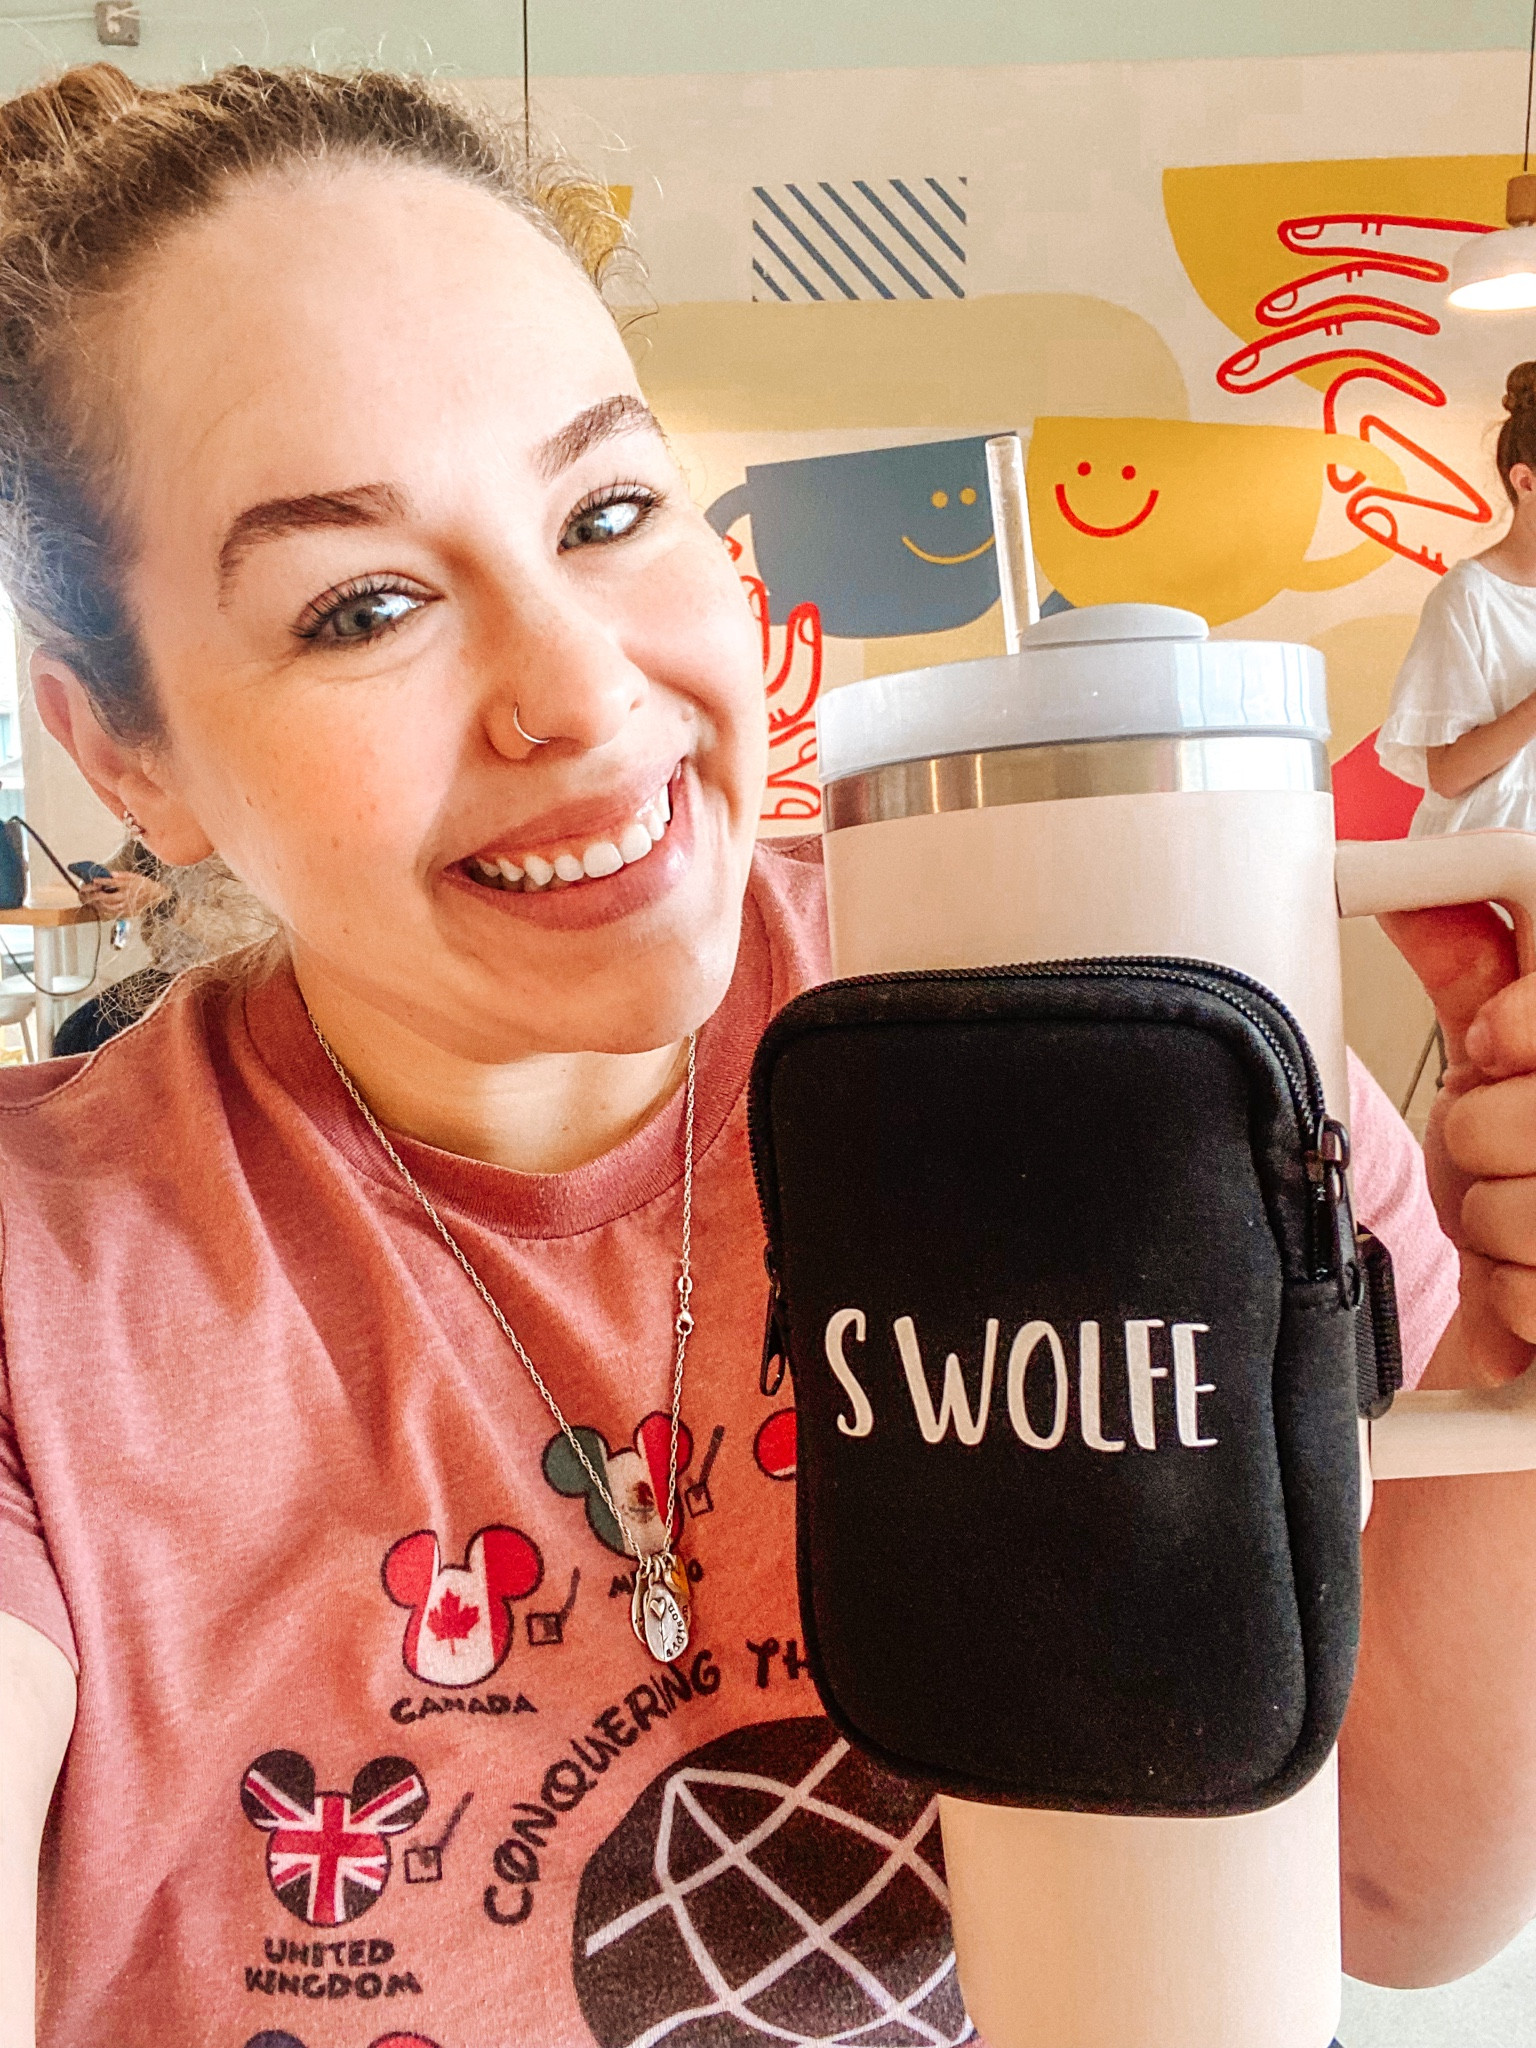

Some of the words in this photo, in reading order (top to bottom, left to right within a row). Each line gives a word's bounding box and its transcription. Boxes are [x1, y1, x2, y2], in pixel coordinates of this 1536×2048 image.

[825, 1308, 874, 1437] S
[893, 1315, 1218, 1452] WOLFE
[390, 1692, 538, 1725] CANADA
[483, 1649, 721, 1927] CONQUERING
[746, 1637, 808, 1689] TH
[264, 1936, 396, 1967] UNITED
[244, 1966, 423, 2000] KINGDOM
